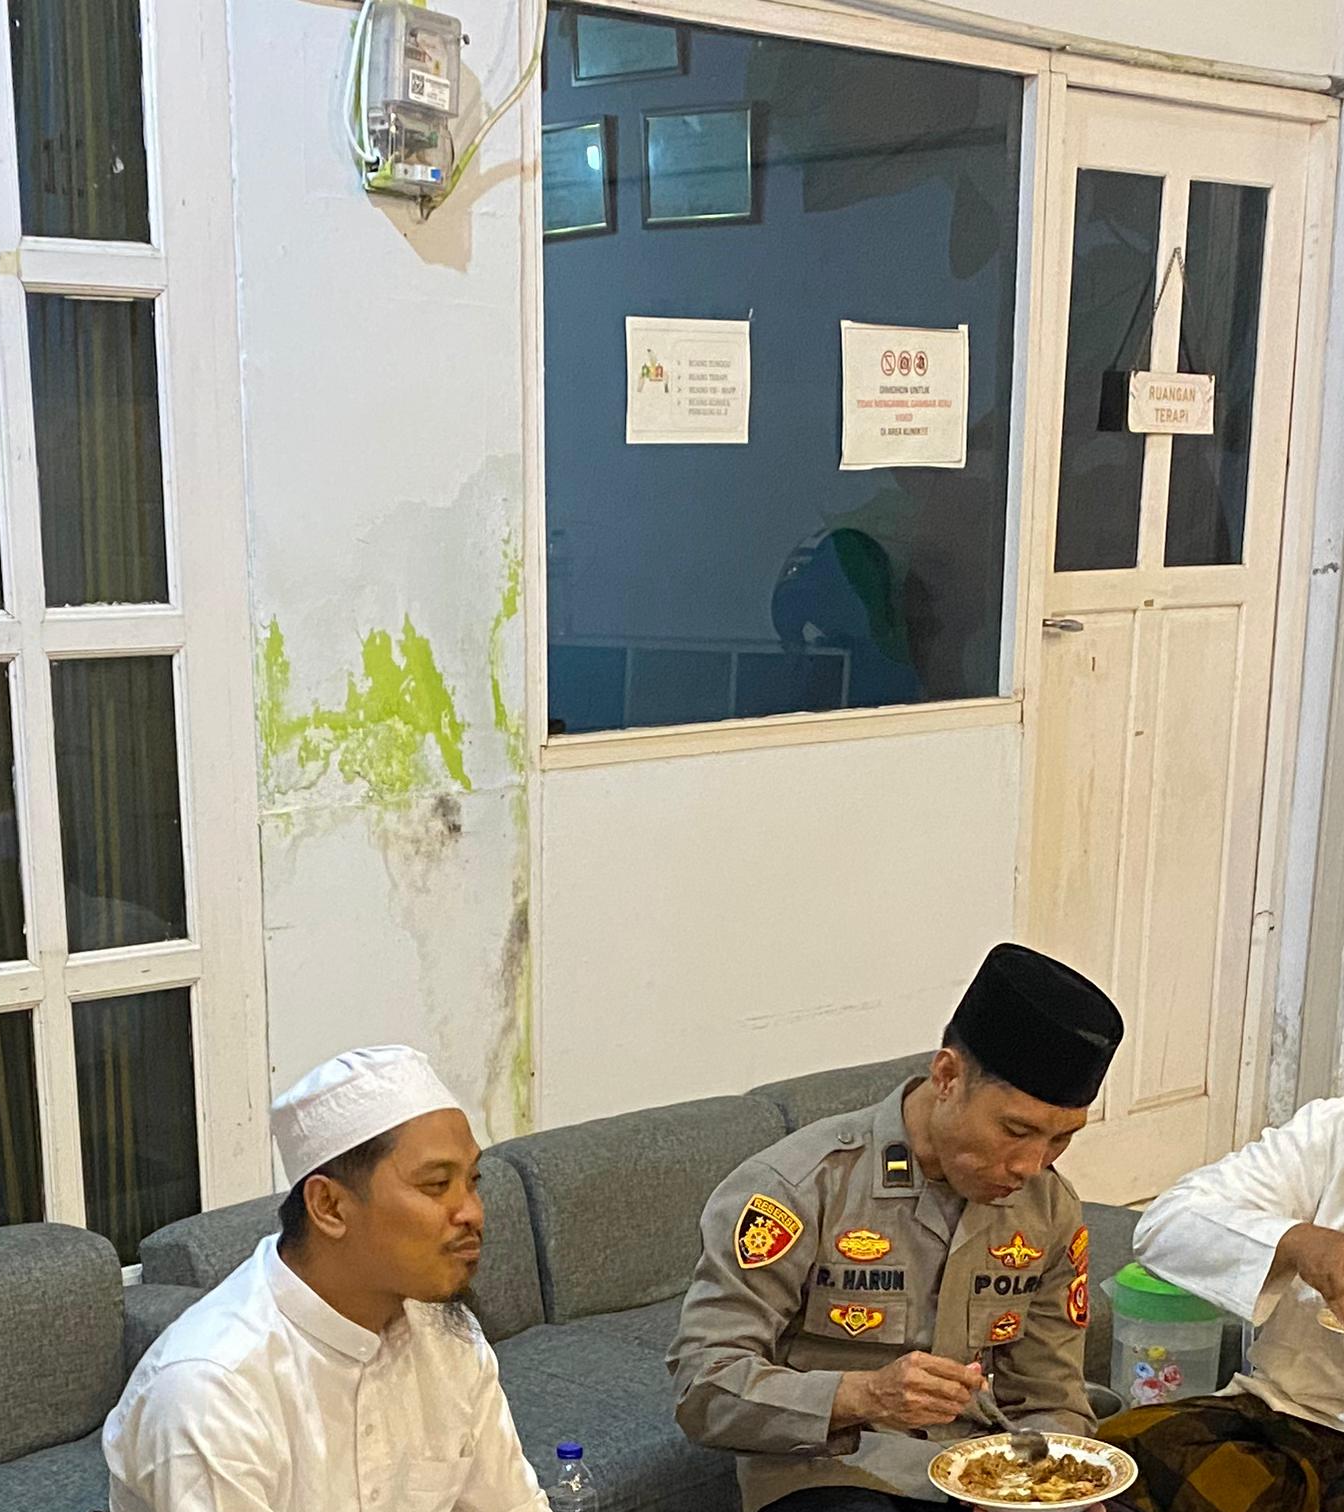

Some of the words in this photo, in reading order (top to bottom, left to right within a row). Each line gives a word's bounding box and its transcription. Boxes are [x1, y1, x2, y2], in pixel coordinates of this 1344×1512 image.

[1148, 386, 1196, 402] RUANGAN
[1154, 407, 1190, 424] TERAPI
[816, 1267, 836, 1288] R.
[842, 1269, 905, 1291] HARUN
